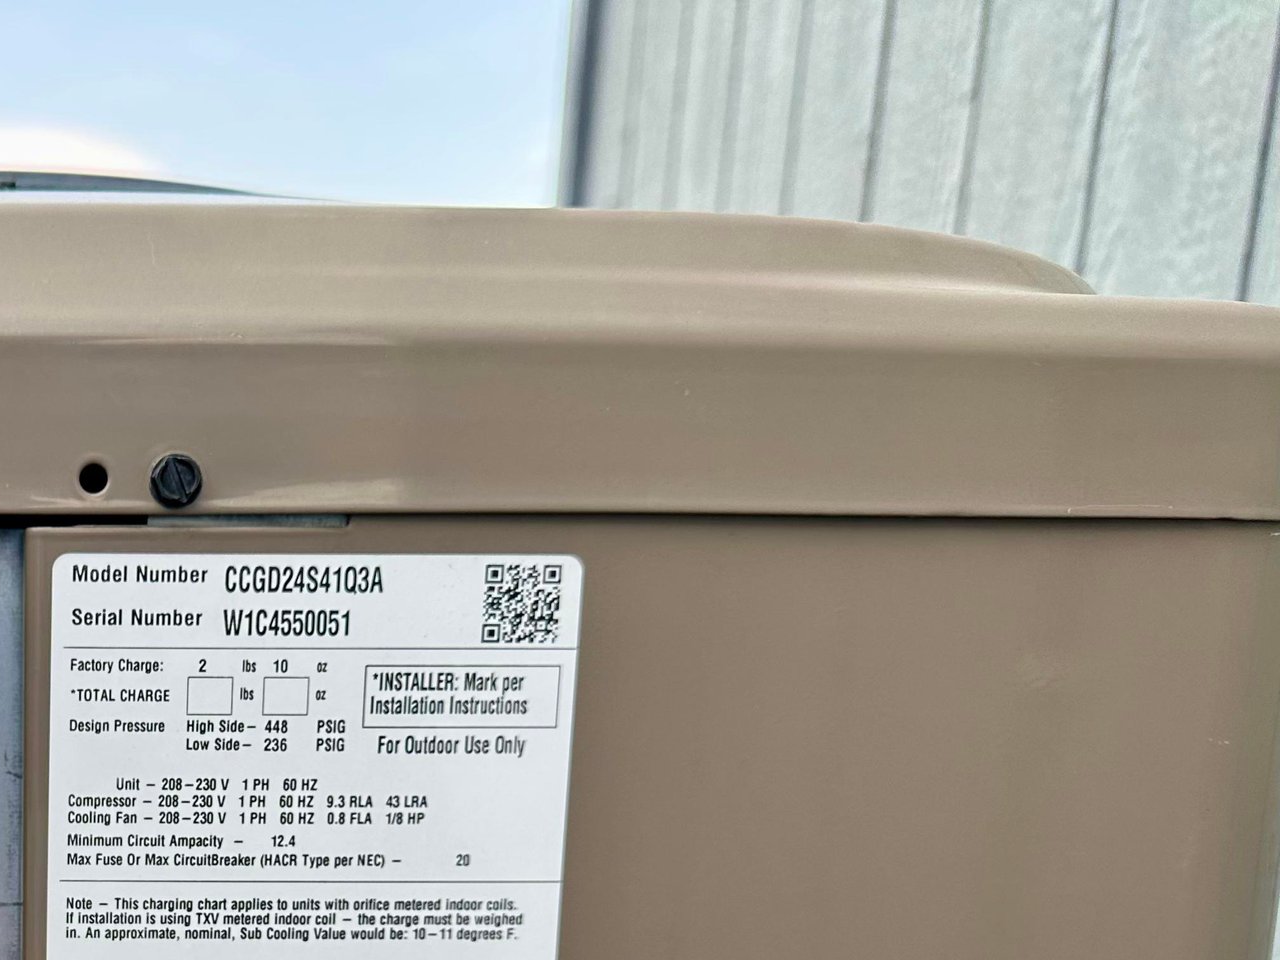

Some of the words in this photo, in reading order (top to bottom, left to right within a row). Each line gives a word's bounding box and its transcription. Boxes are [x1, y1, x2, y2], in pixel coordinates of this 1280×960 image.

[72, 564, 127, 582] Model
[136, 565, 207, 582] Number
[225, 565, 383, 594] CCGD24S41Q3A
[71, 608, 122, 625] Serial
[131, 608, 202, 626] Number
[223, 609, 349, 636] W1C4550051
[70, 658, 113, 673] Factory
[118, 658, 163, 674] Charge:
[198, 658, 206, 672] 2
[242, 659, 256, 672] lbs
[273, 658, 288, 673] 10
[316, 662, 327, 673] oz
[463, 672, 497, 691] Mark
[501, 676, 524, 695] per
[120, 688, 169, 702] CHARGE
[369, 695, 444, 714] Installation
[449, 695, 527, 714] Instructions
[69, 718, 109, 734] Design
[114, 719, 164, 732] Pressure
[377, 735, 400, 754] For
[404, 735, 459, 754] Outdoor
[464, 735, 489, 754] Use
[494, 735, 525, 757] Only
[67, 833, 122, 846] Minimum
[127, 833, 165, 847] Circuit
[169, 834, 223, 849] Ampacity
[271, 834, 295, 847] 12.4
